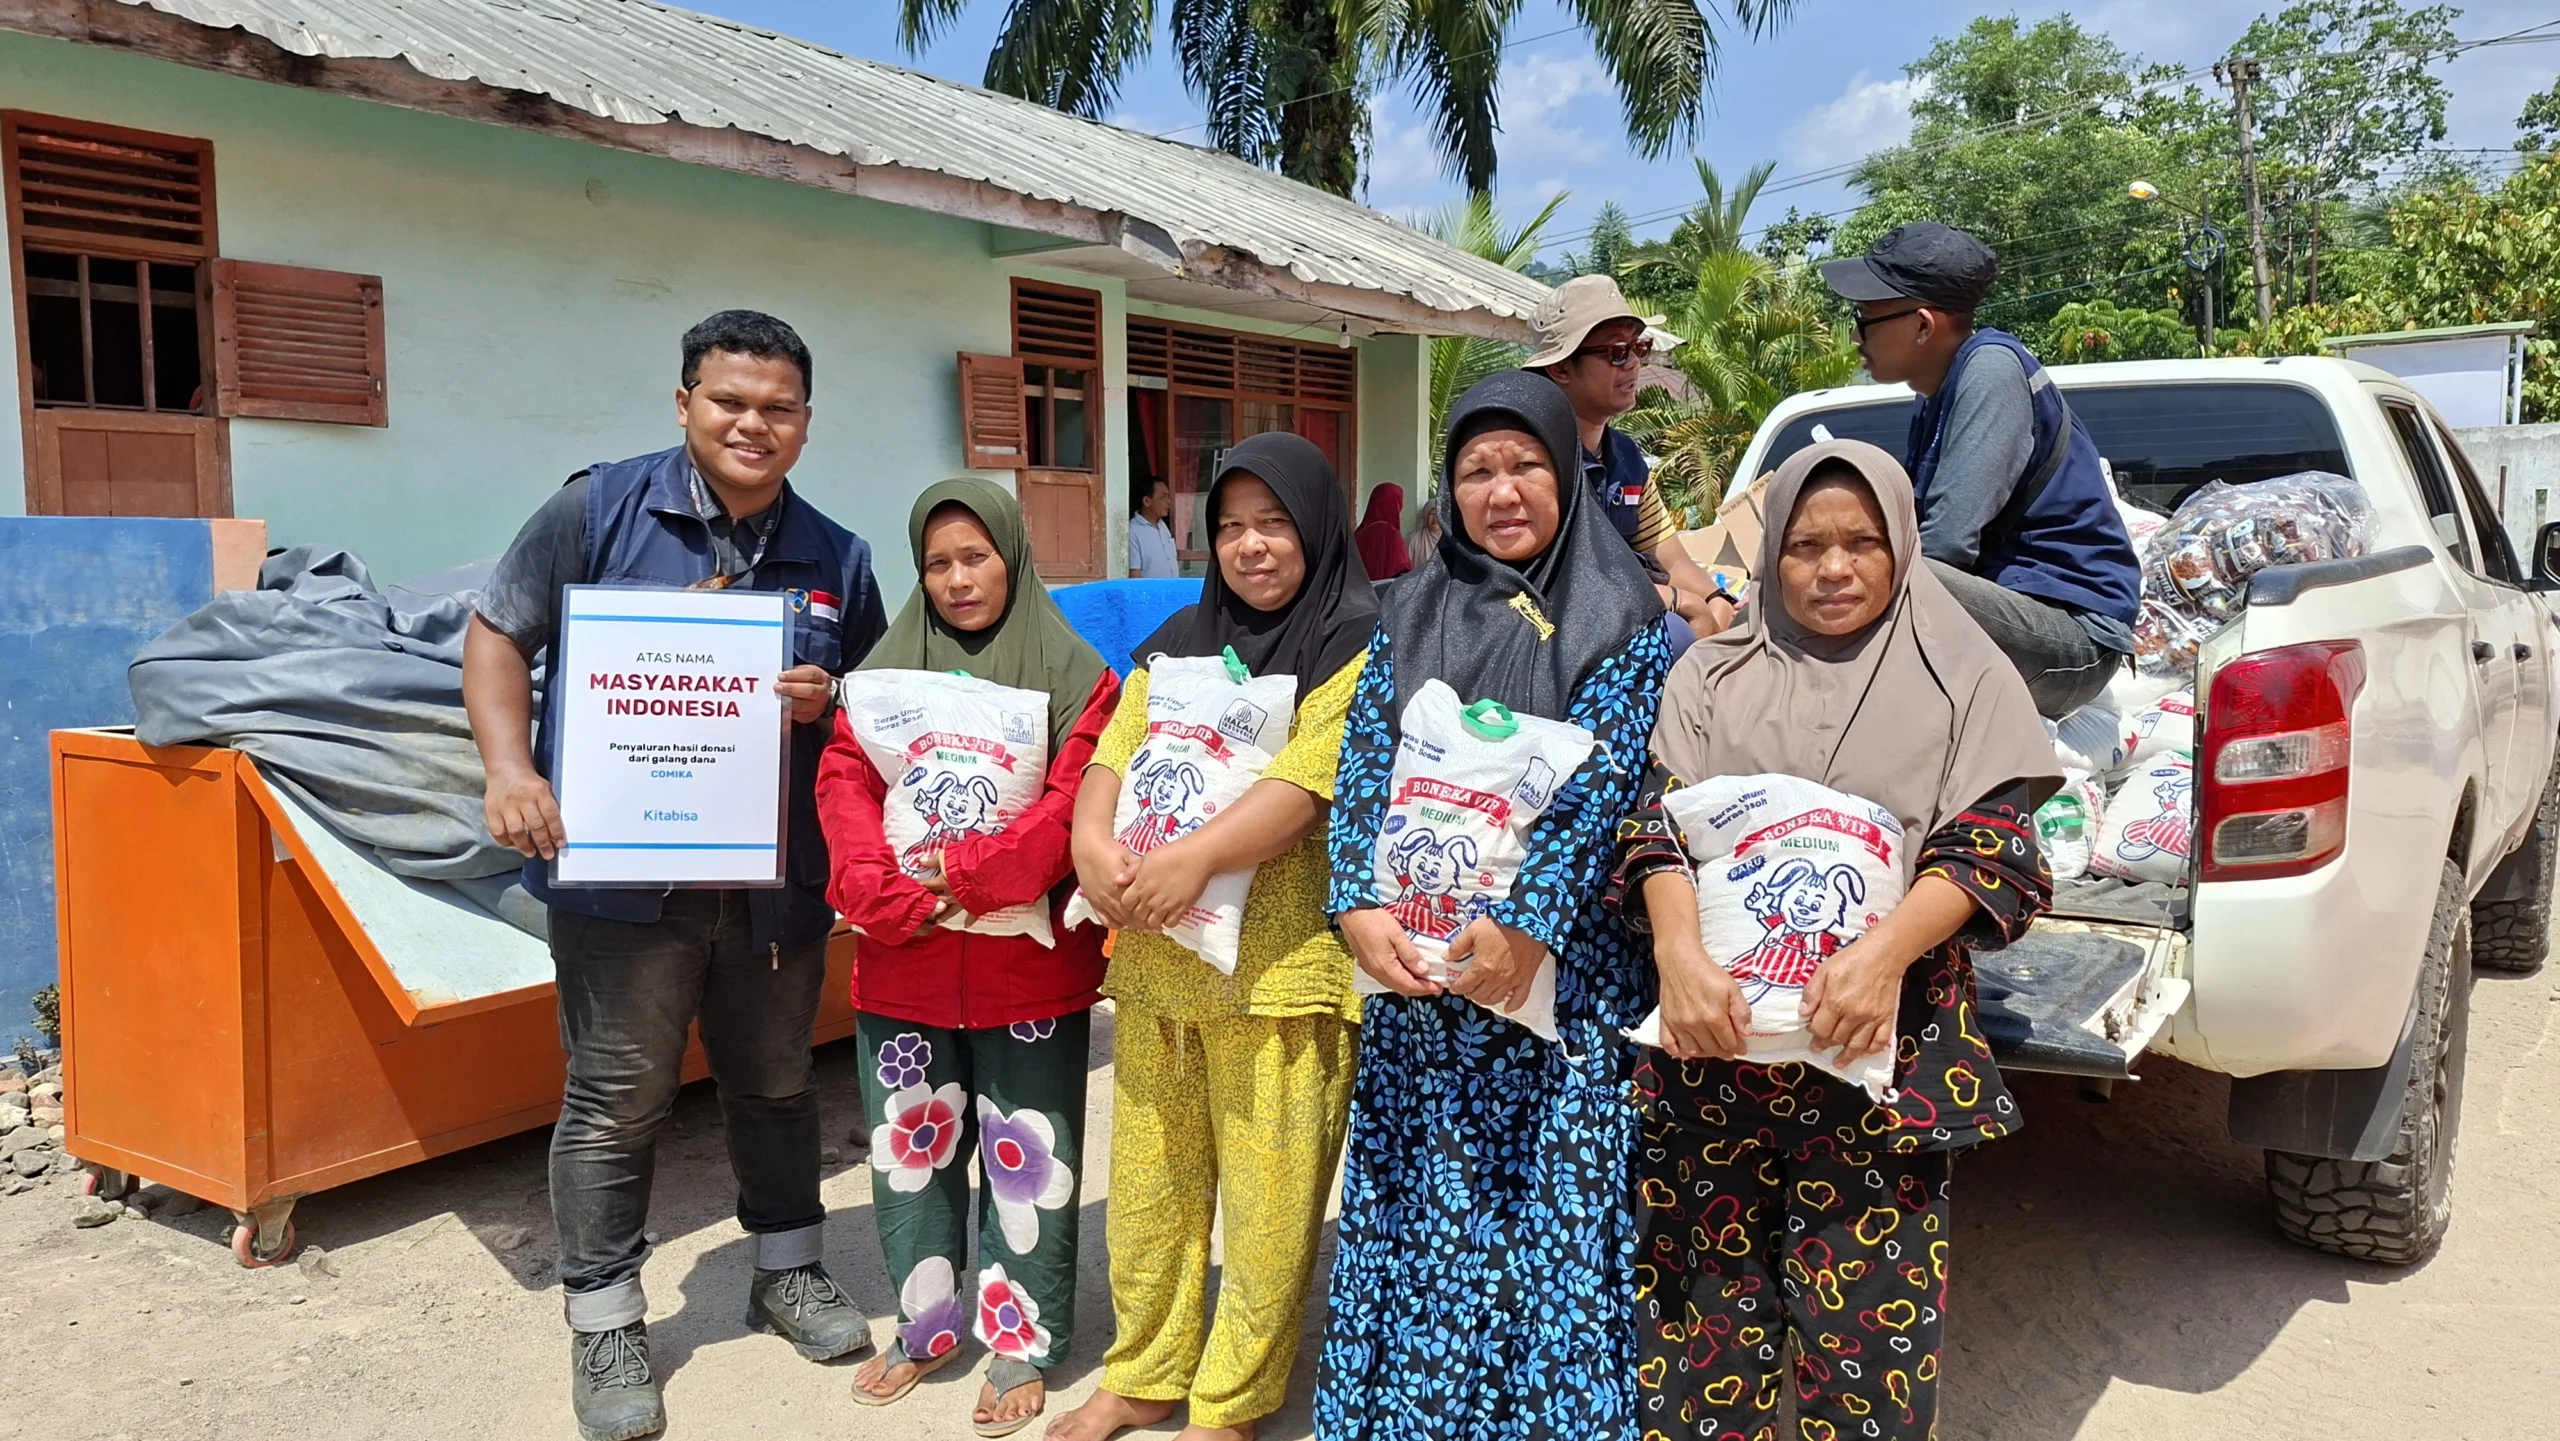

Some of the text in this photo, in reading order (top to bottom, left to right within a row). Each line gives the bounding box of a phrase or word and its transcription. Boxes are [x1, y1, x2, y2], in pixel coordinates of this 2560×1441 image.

[636, 652, 715, 665] ATAS NAMA
[590, 673, 760, 693] MASYARAKAT
[607, 699, 741, 718] INDONESIA
[1224, 714, 1255, 735] HALAL
[610, 742, 736, 753] Penyaluran hasil donasi
[628, 753, 716, 765] dari galang dana
[651, 770, 693, 779] COMIKA
[1412, 781, 1472, 803] BONEKA
[1474, 795, 1500, 811] VIP
[644, 809, 698, 822] Kitabisa
[1420, 806, 1467, 826] MEDIUM
[1385, 818, 1404, 831] BARU
[1762, 811, 1833, 841] BONEKA
[1836, 816, 1869, 835] VIP
[1780, 837, 1840, 852] MEDIUM
